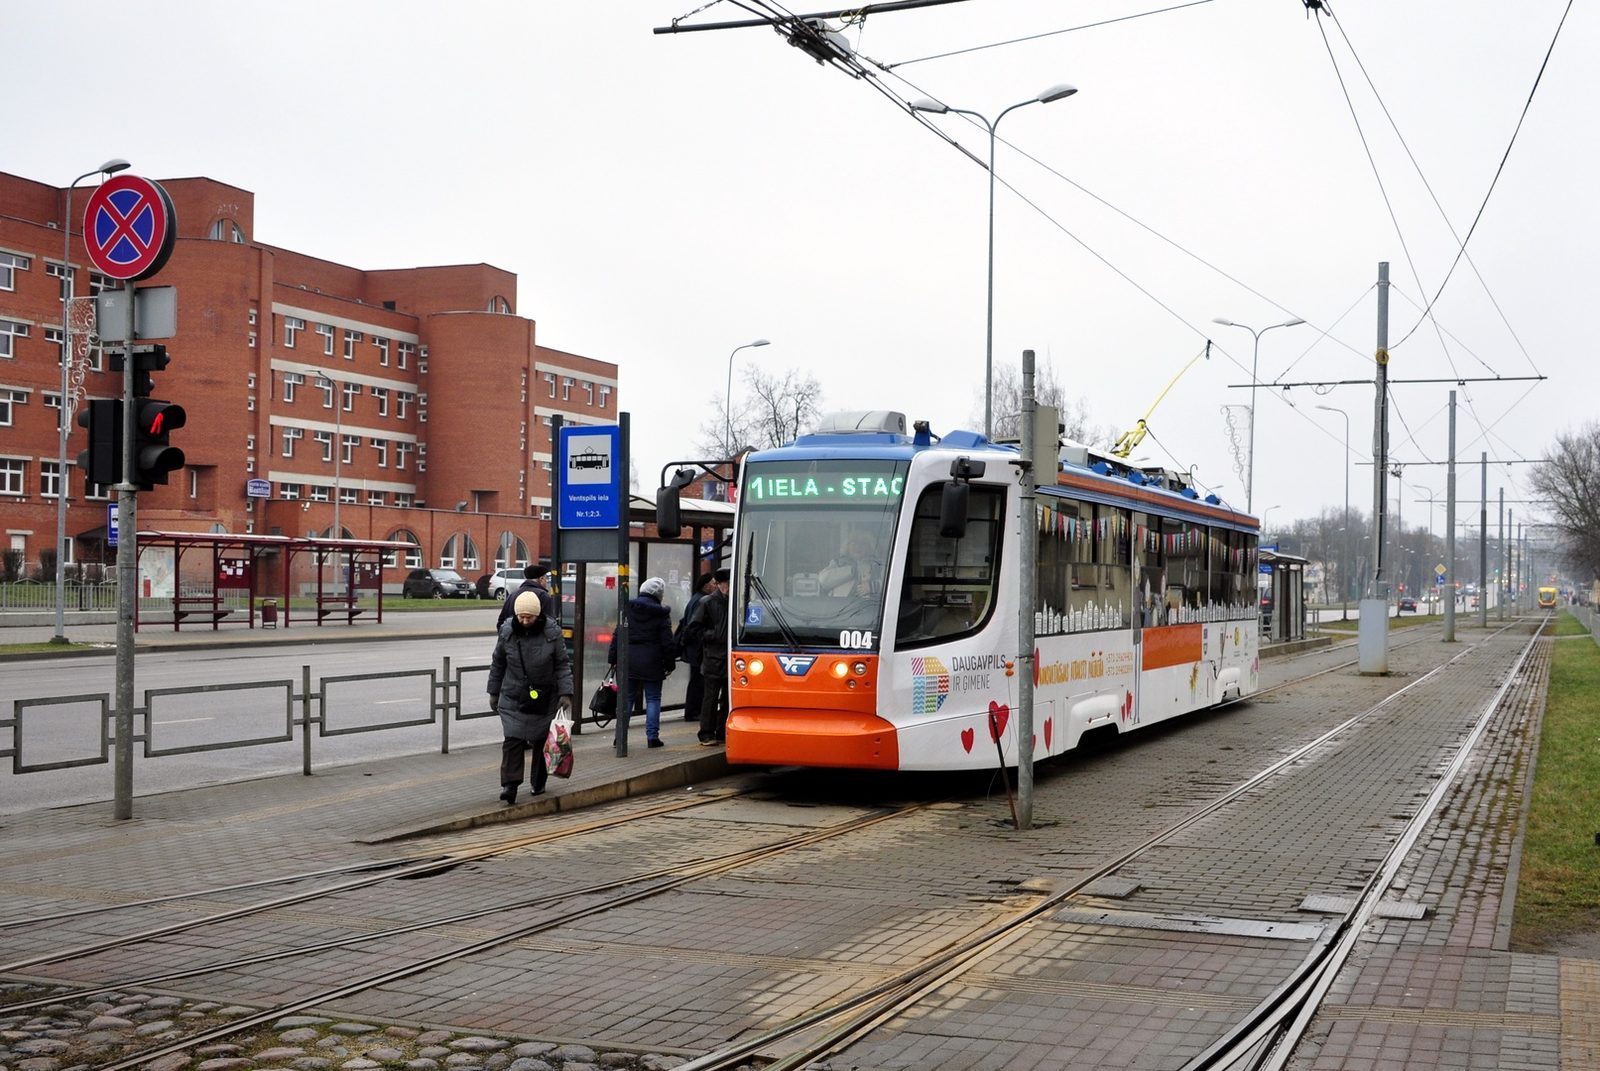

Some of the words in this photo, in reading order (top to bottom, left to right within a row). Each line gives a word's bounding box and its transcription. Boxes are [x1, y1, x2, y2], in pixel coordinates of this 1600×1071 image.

[751, 477, 763, 499] 1
[769, 478, 819, 496] IELA
[839, 630, 873, 650] 004
[952, 654, 1006, 672] DAUGAVPILS
[952, 675, 961, 691] IR
